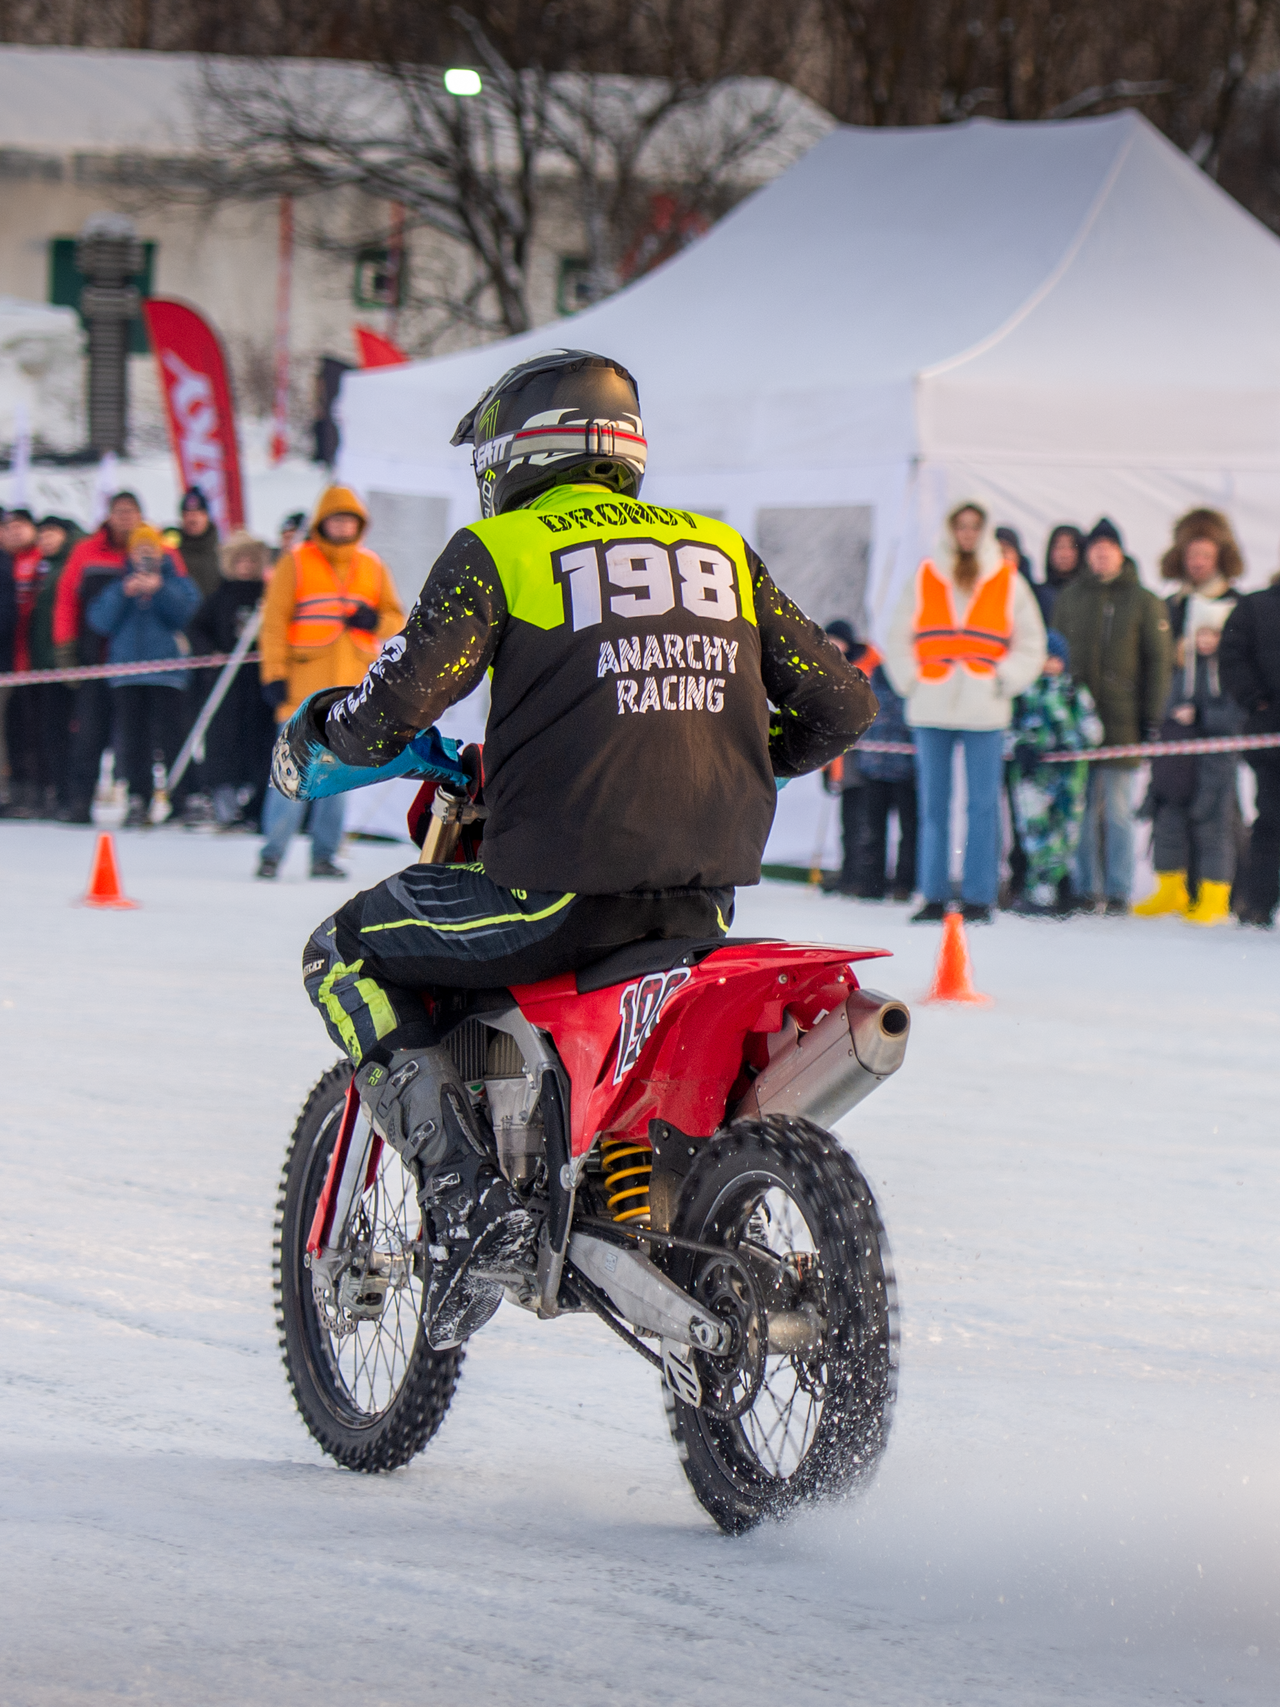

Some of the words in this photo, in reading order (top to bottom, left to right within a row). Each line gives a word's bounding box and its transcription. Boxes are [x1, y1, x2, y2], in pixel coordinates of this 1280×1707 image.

[560, 543, 738, 632] 198
[597, 635, 738, 677] ANARCHY
[617, 676, 726, 715] RACING
